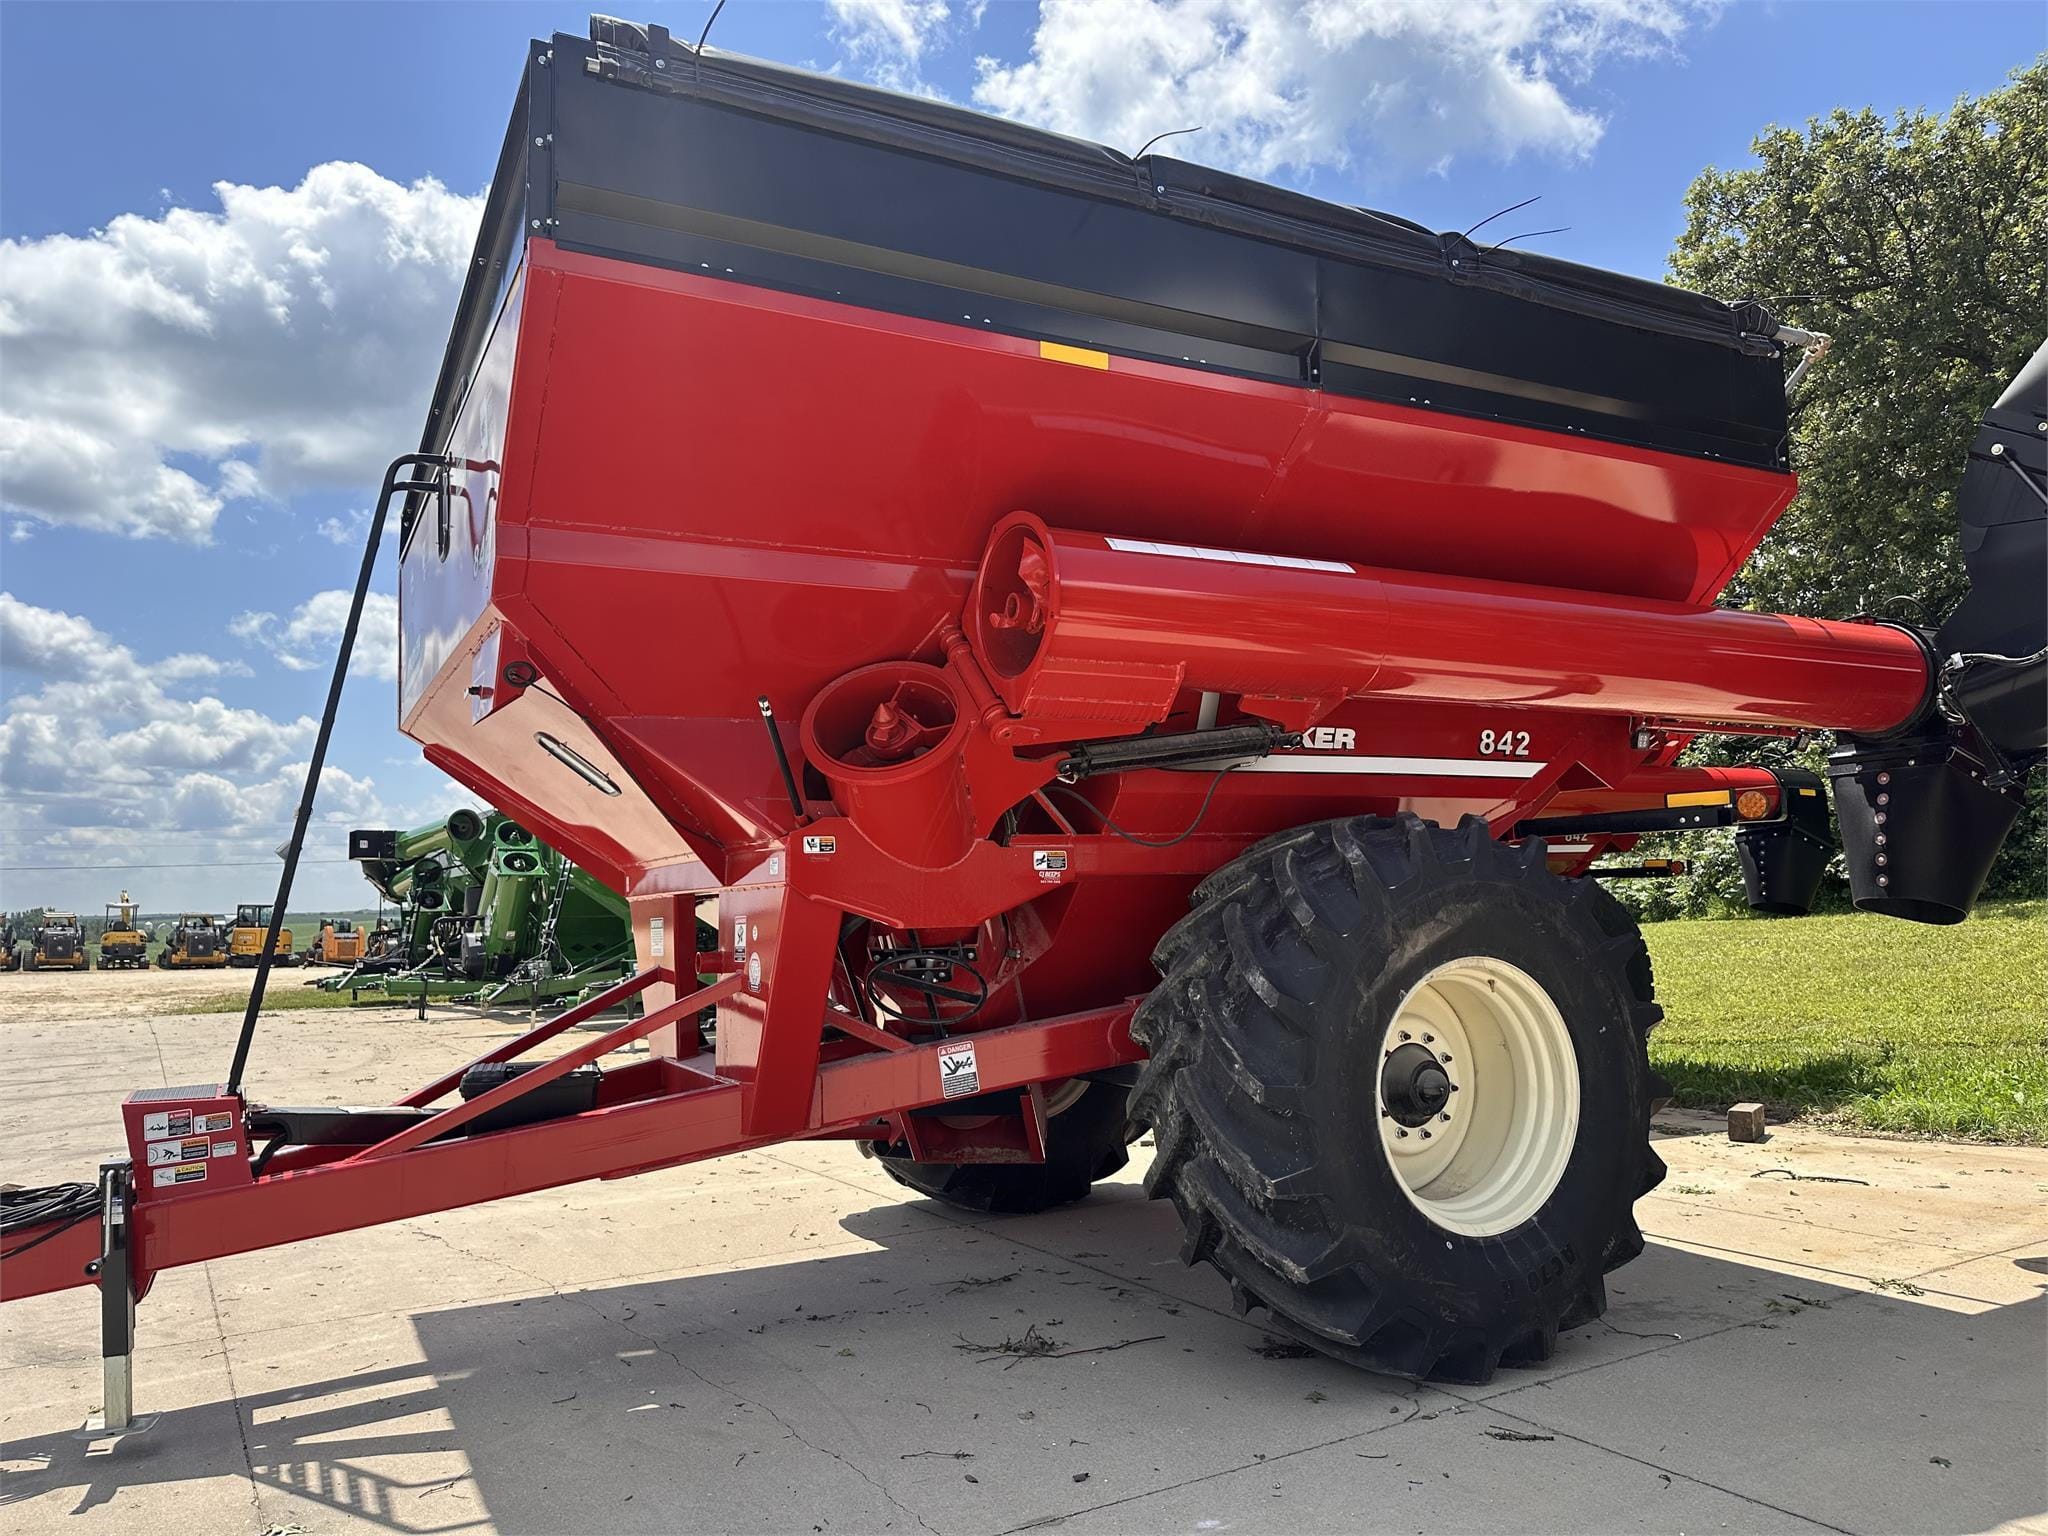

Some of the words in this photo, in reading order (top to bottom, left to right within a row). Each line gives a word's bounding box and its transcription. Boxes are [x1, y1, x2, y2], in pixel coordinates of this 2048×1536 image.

[1480, 729, 1530, 756] 842
[947, 1043, 971, 1054] DANGER
[181, 1164, 205, 1172] CAUTION
